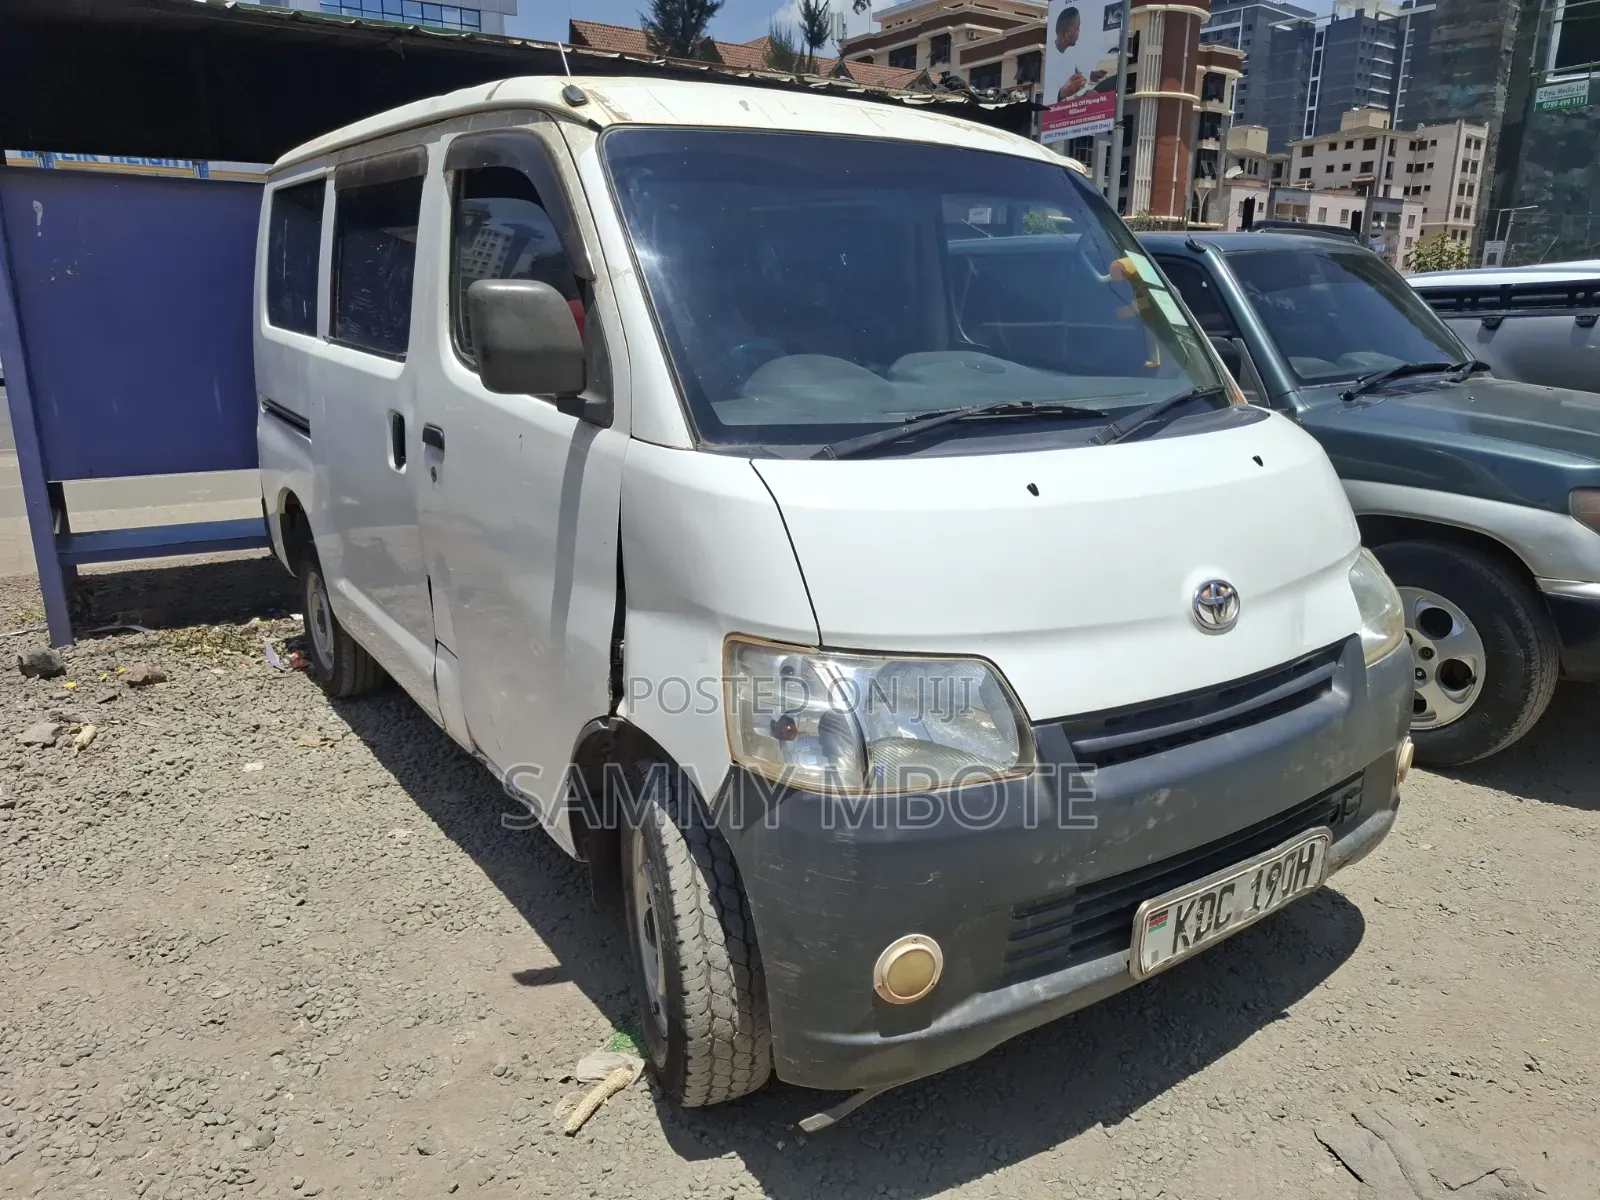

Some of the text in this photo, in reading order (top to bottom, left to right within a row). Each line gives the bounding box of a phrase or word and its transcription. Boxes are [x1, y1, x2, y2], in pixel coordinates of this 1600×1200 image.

[1558, 86, 1575, 94] Media
[1573, 96, 1584, 104] 111
[1172, 843, 1316, 954] KDC 190H
